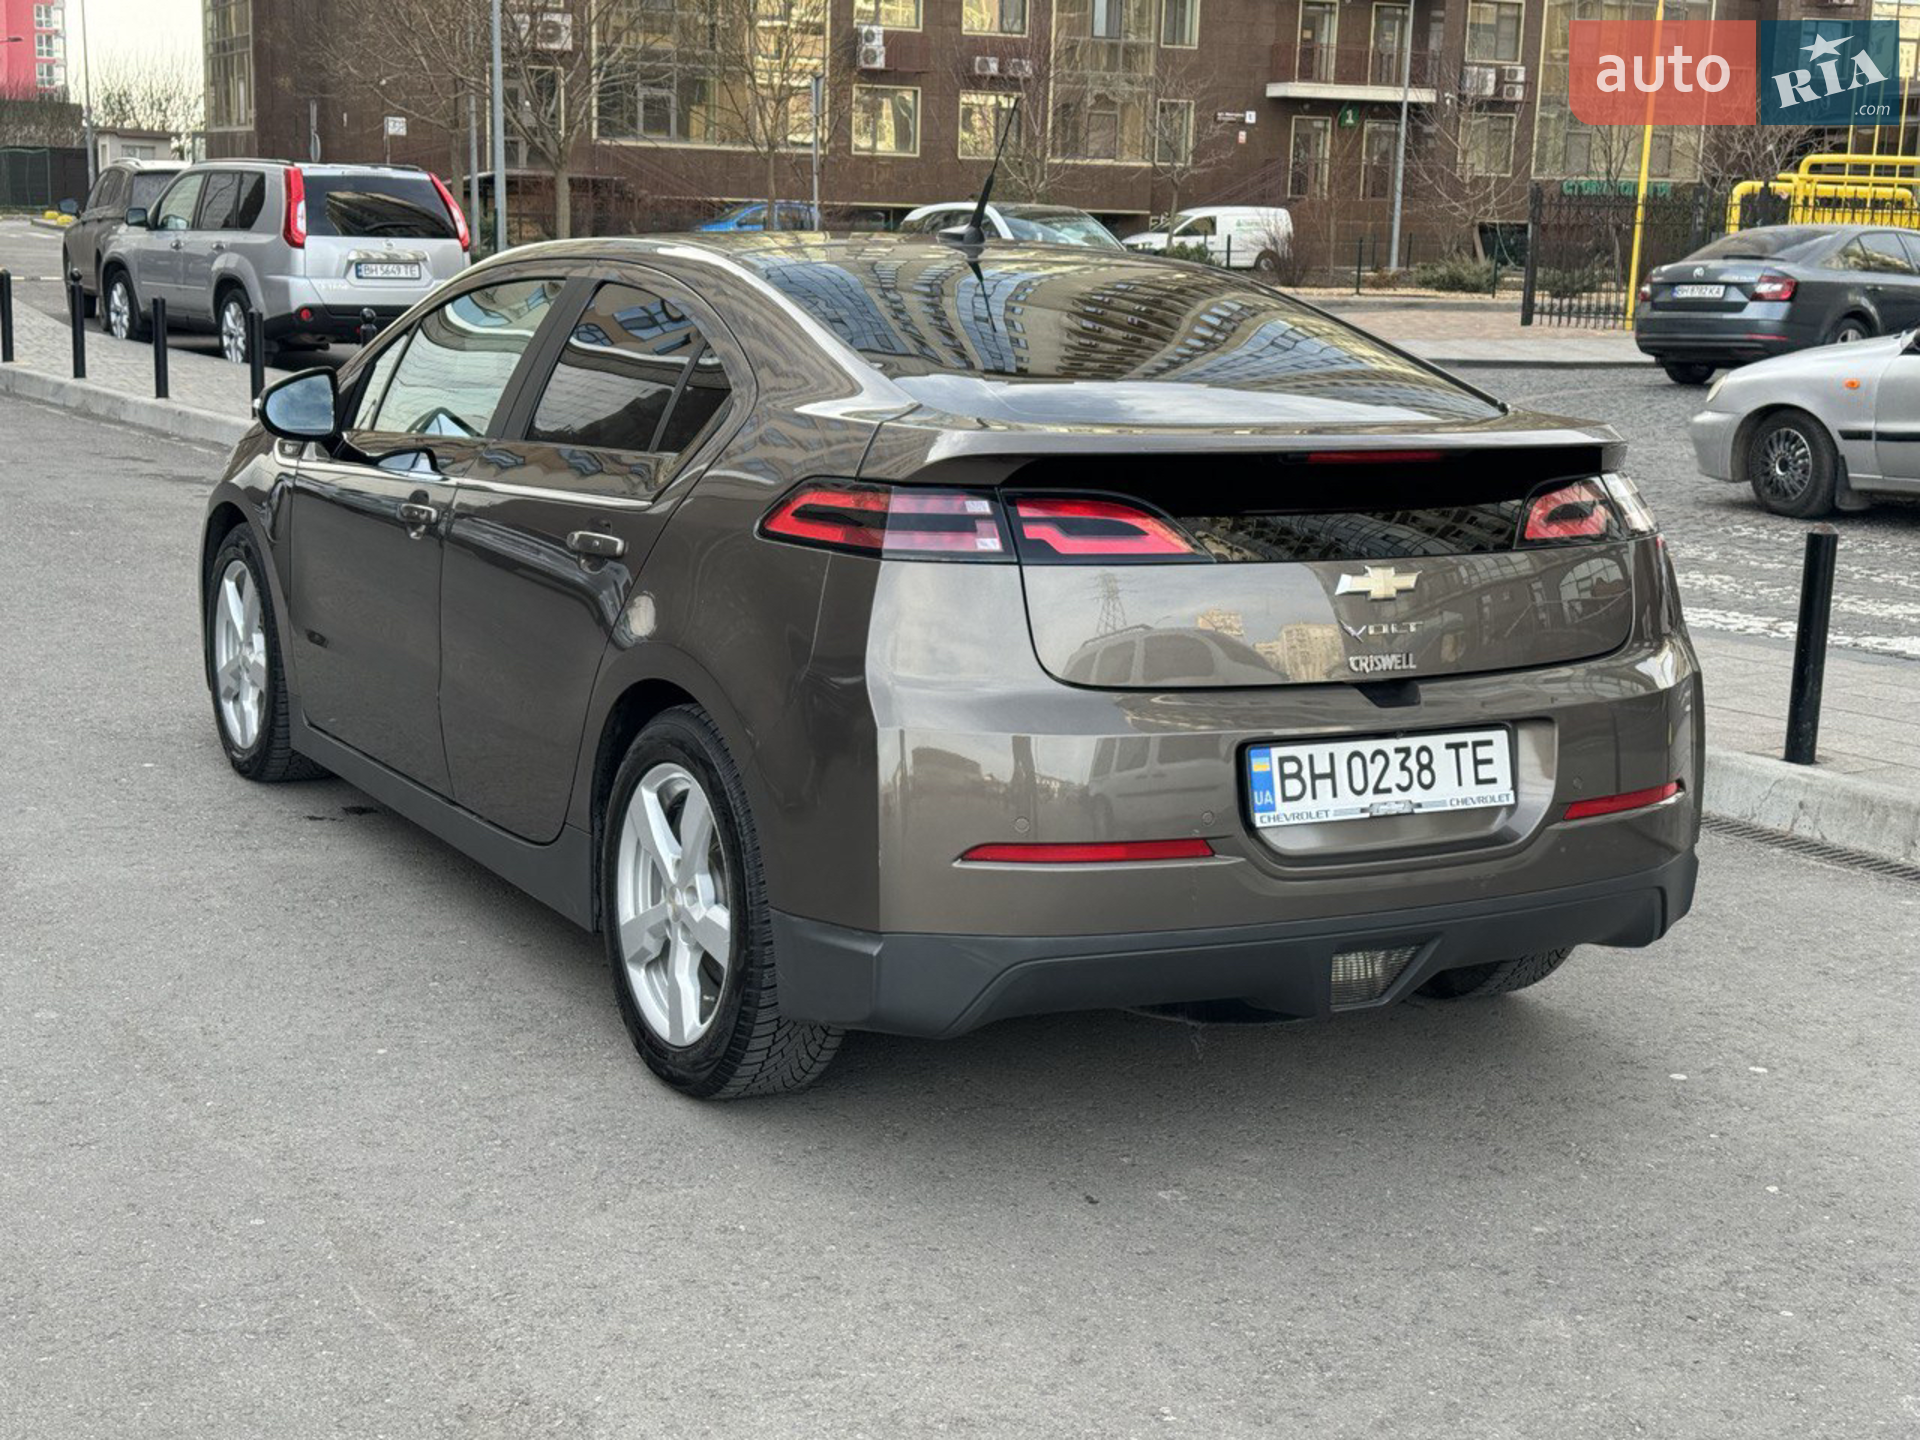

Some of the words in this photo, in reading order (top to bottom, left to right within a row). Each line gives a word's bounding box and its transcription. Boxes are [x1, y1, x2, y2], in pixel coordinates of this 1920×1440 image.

[1339, 619, 1423, 643] VOLT
[1278, 752, 1337, 802] BH
[1346, 745, 1436, 796] 0238
[1445, 739, 1498, 787] TE
[1254, 791, 1273, 805] UA
[1449, 793, 1512, 808] CHEVROLET
[1259, 809, 1331, 825] CHEVROLET
